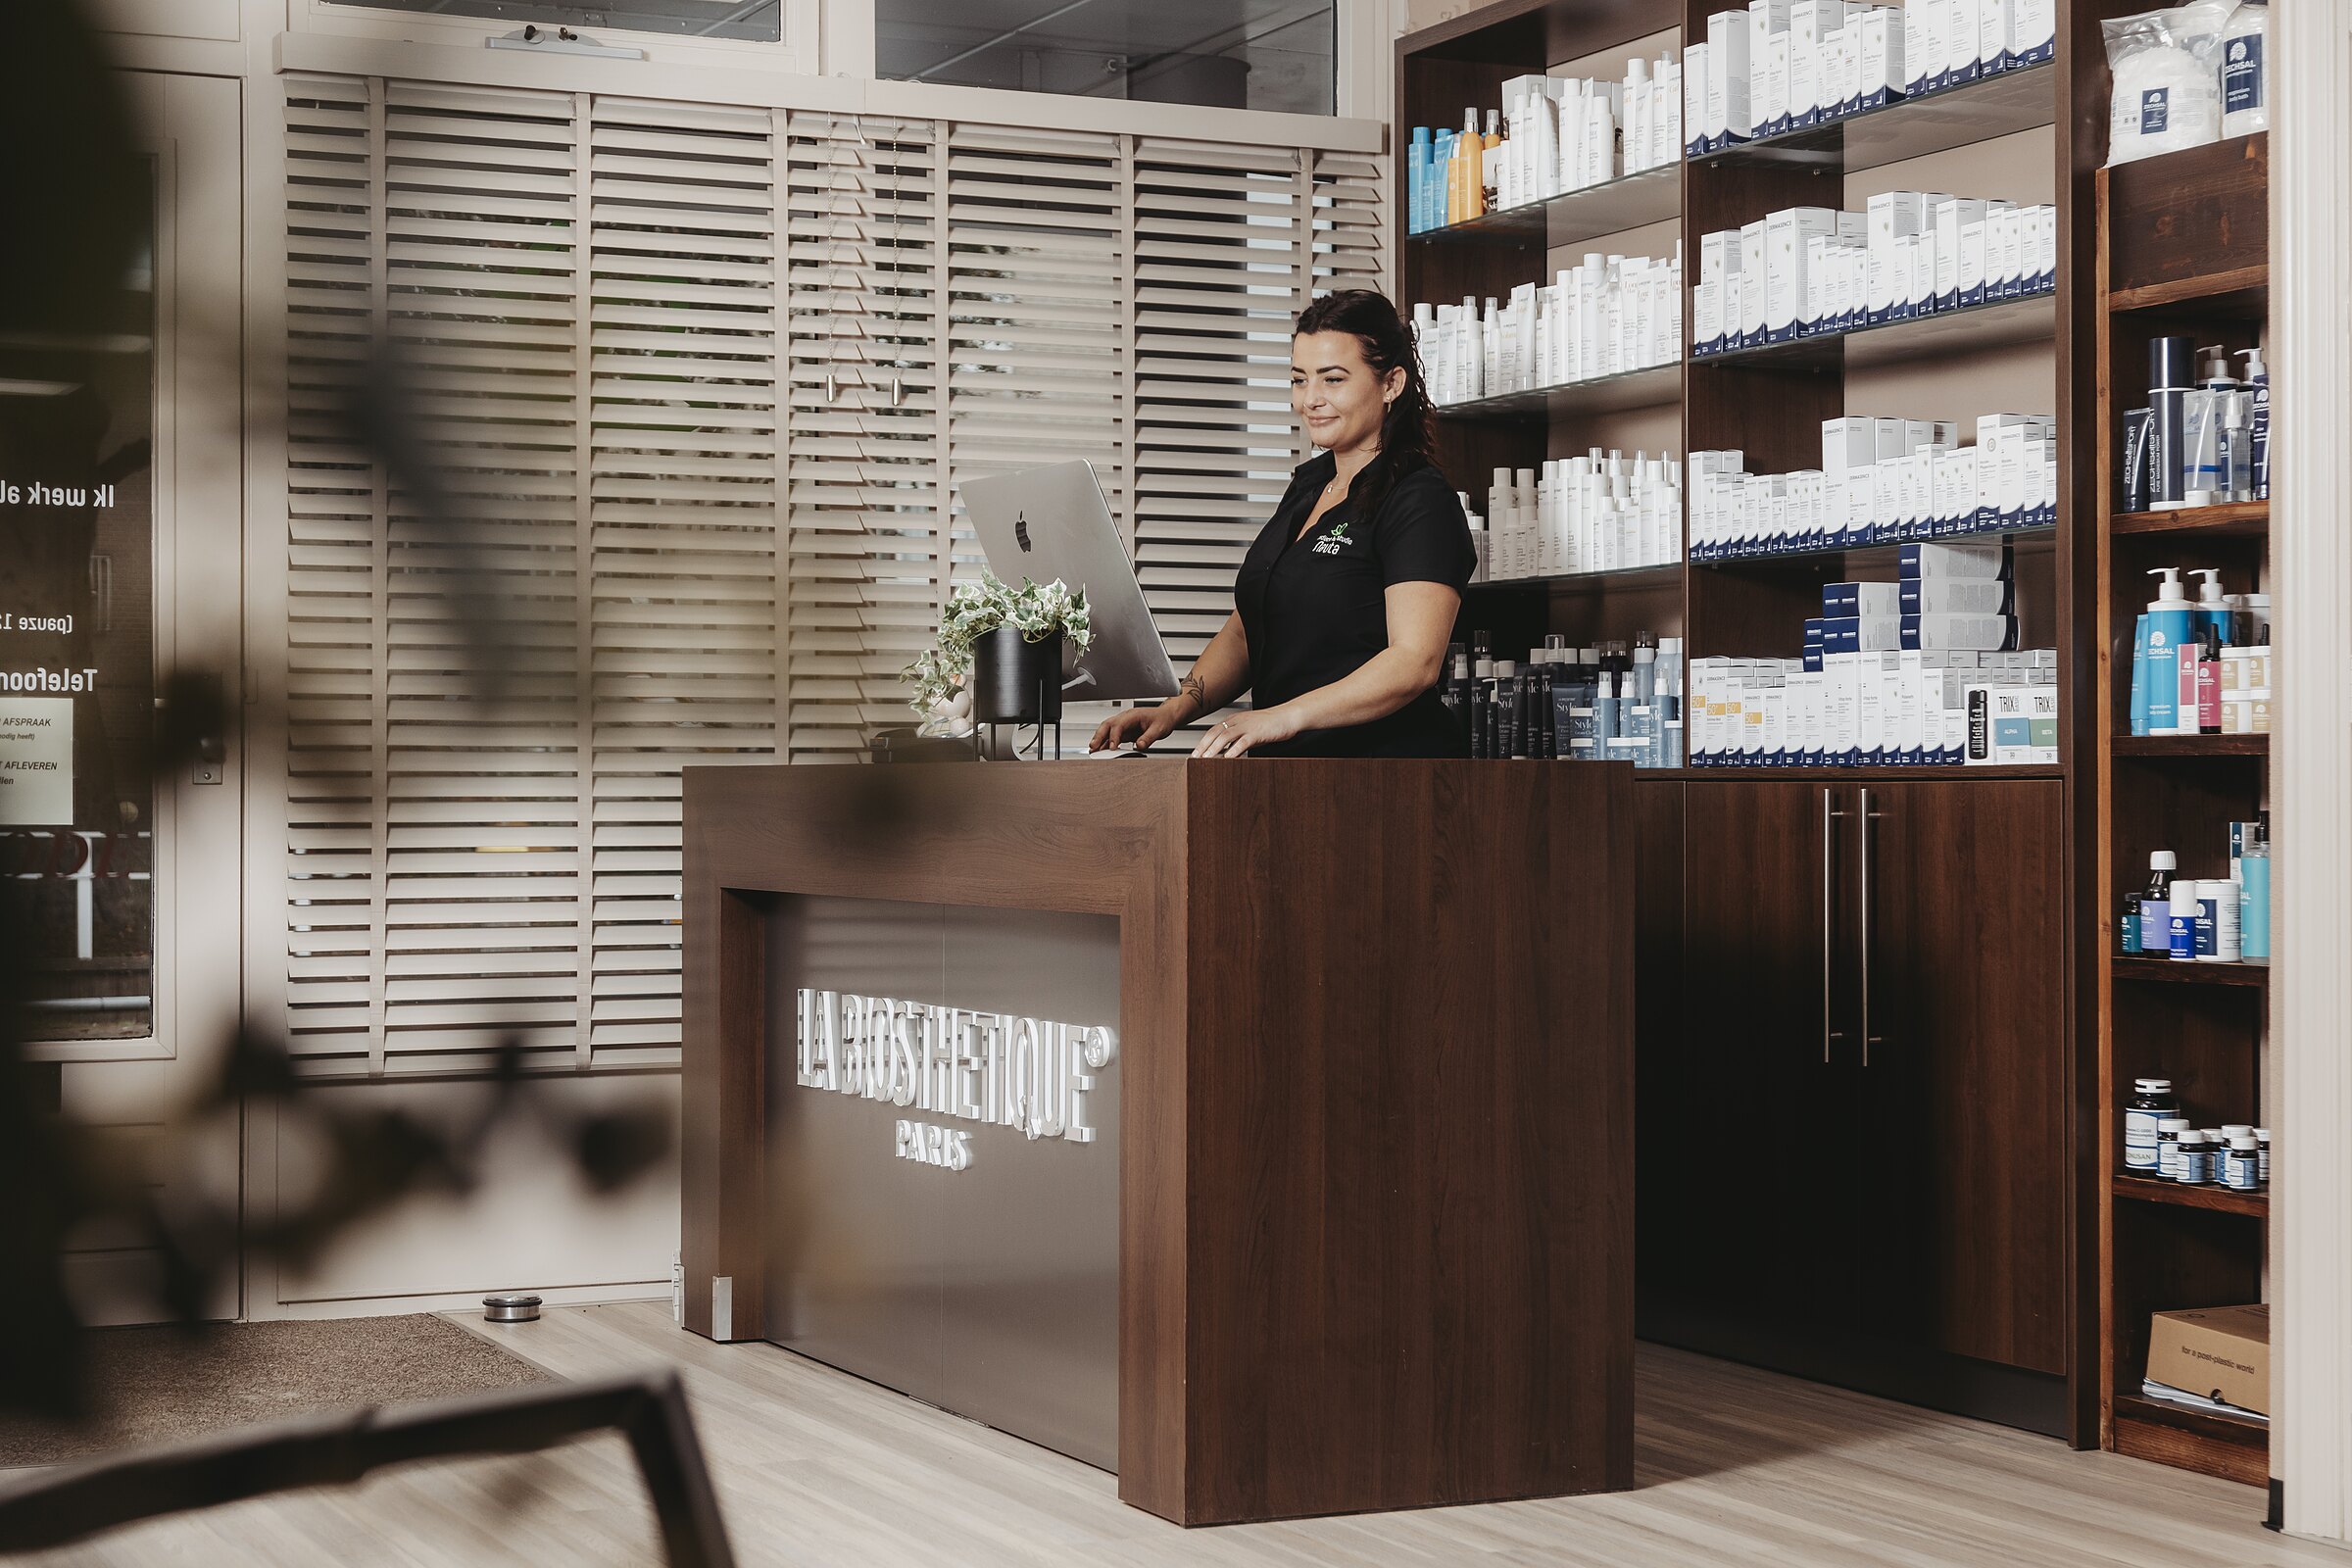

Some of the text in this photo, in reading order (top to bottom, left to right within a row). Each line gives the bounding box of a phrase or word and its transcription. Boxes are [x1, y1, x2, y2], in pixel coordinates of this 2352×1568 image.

[1999, 696, 2015, 712] TRIX
[2034, 697, 2051, 713] TRIX
[3, 717, 52, 727] AFSPRAAK
[4, 761, 58, 771] AFLEVEREN
[797, 988, 841, 1091] LA
[895, 1119, 973, 1171] PARIS
[2181, 1346, 2191, 1355] for
[2235, 1362, 2255, 1375] world
